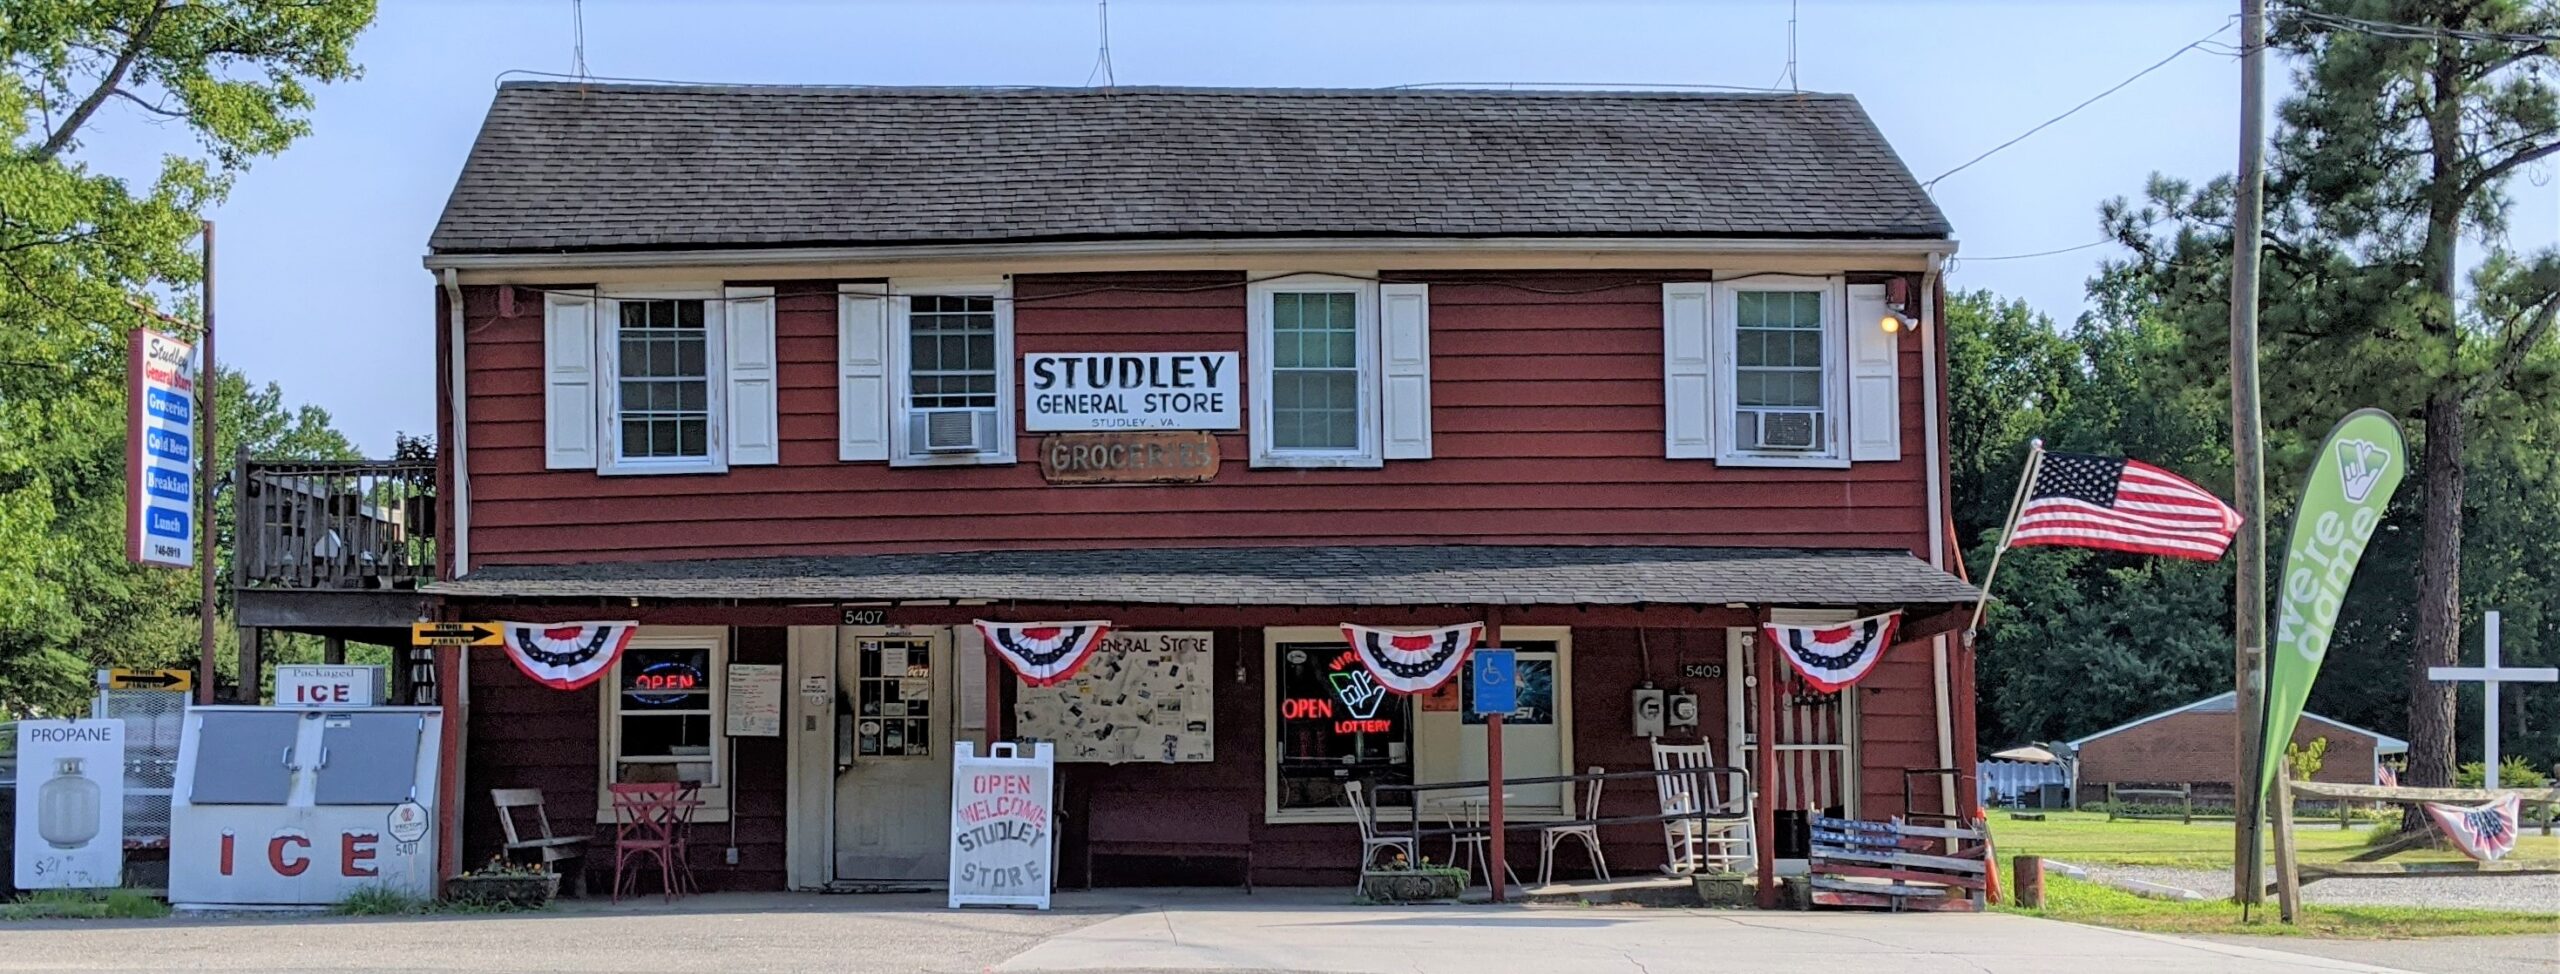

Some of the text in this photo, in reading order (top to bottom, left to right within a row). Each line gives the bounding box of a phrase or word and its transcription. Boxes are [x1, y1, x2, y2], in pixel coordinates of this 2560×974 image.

[149, 338, 188, 374] Studley
[145, 360, 192, 392] General Store
[1033, 356, 1225, 390] STUDLEY
[149, 393, 188, 418] Groceries
[1036, 392, 1224, 414] GENERAL STORE
[149, 433, 188, 457] Cold Beer
[148, 471, 188, 495] Breakfast
[154, 513, 181, 533] Lunch
[2278, 511, 2345, 642] we're
[844, 610, 884, 624] 5407
[1093, 638, 1152, 652] ENERAL
[293, 668, 355, 678] Packaged
[636, 674, 694, 690] OPEN
[1686, 665, 1721, 678] 5409
[296, 684, 350, 703] ICE
[1282, 698, 1333, 720] OPEN
[31, 728, 112, 742] PROPANE
[1334, 720, 1392, 733] LOTTERY
[974, 775, 1031, 794] OPEN
[959, 797, 1047, 828] WELCOME
[957, 820, 1045, 852] STUDLEY
[219, 827, 380, 878] ICE
[395, 842, 419, 857] 5407
[961, 860, 1043, 888] STORE
